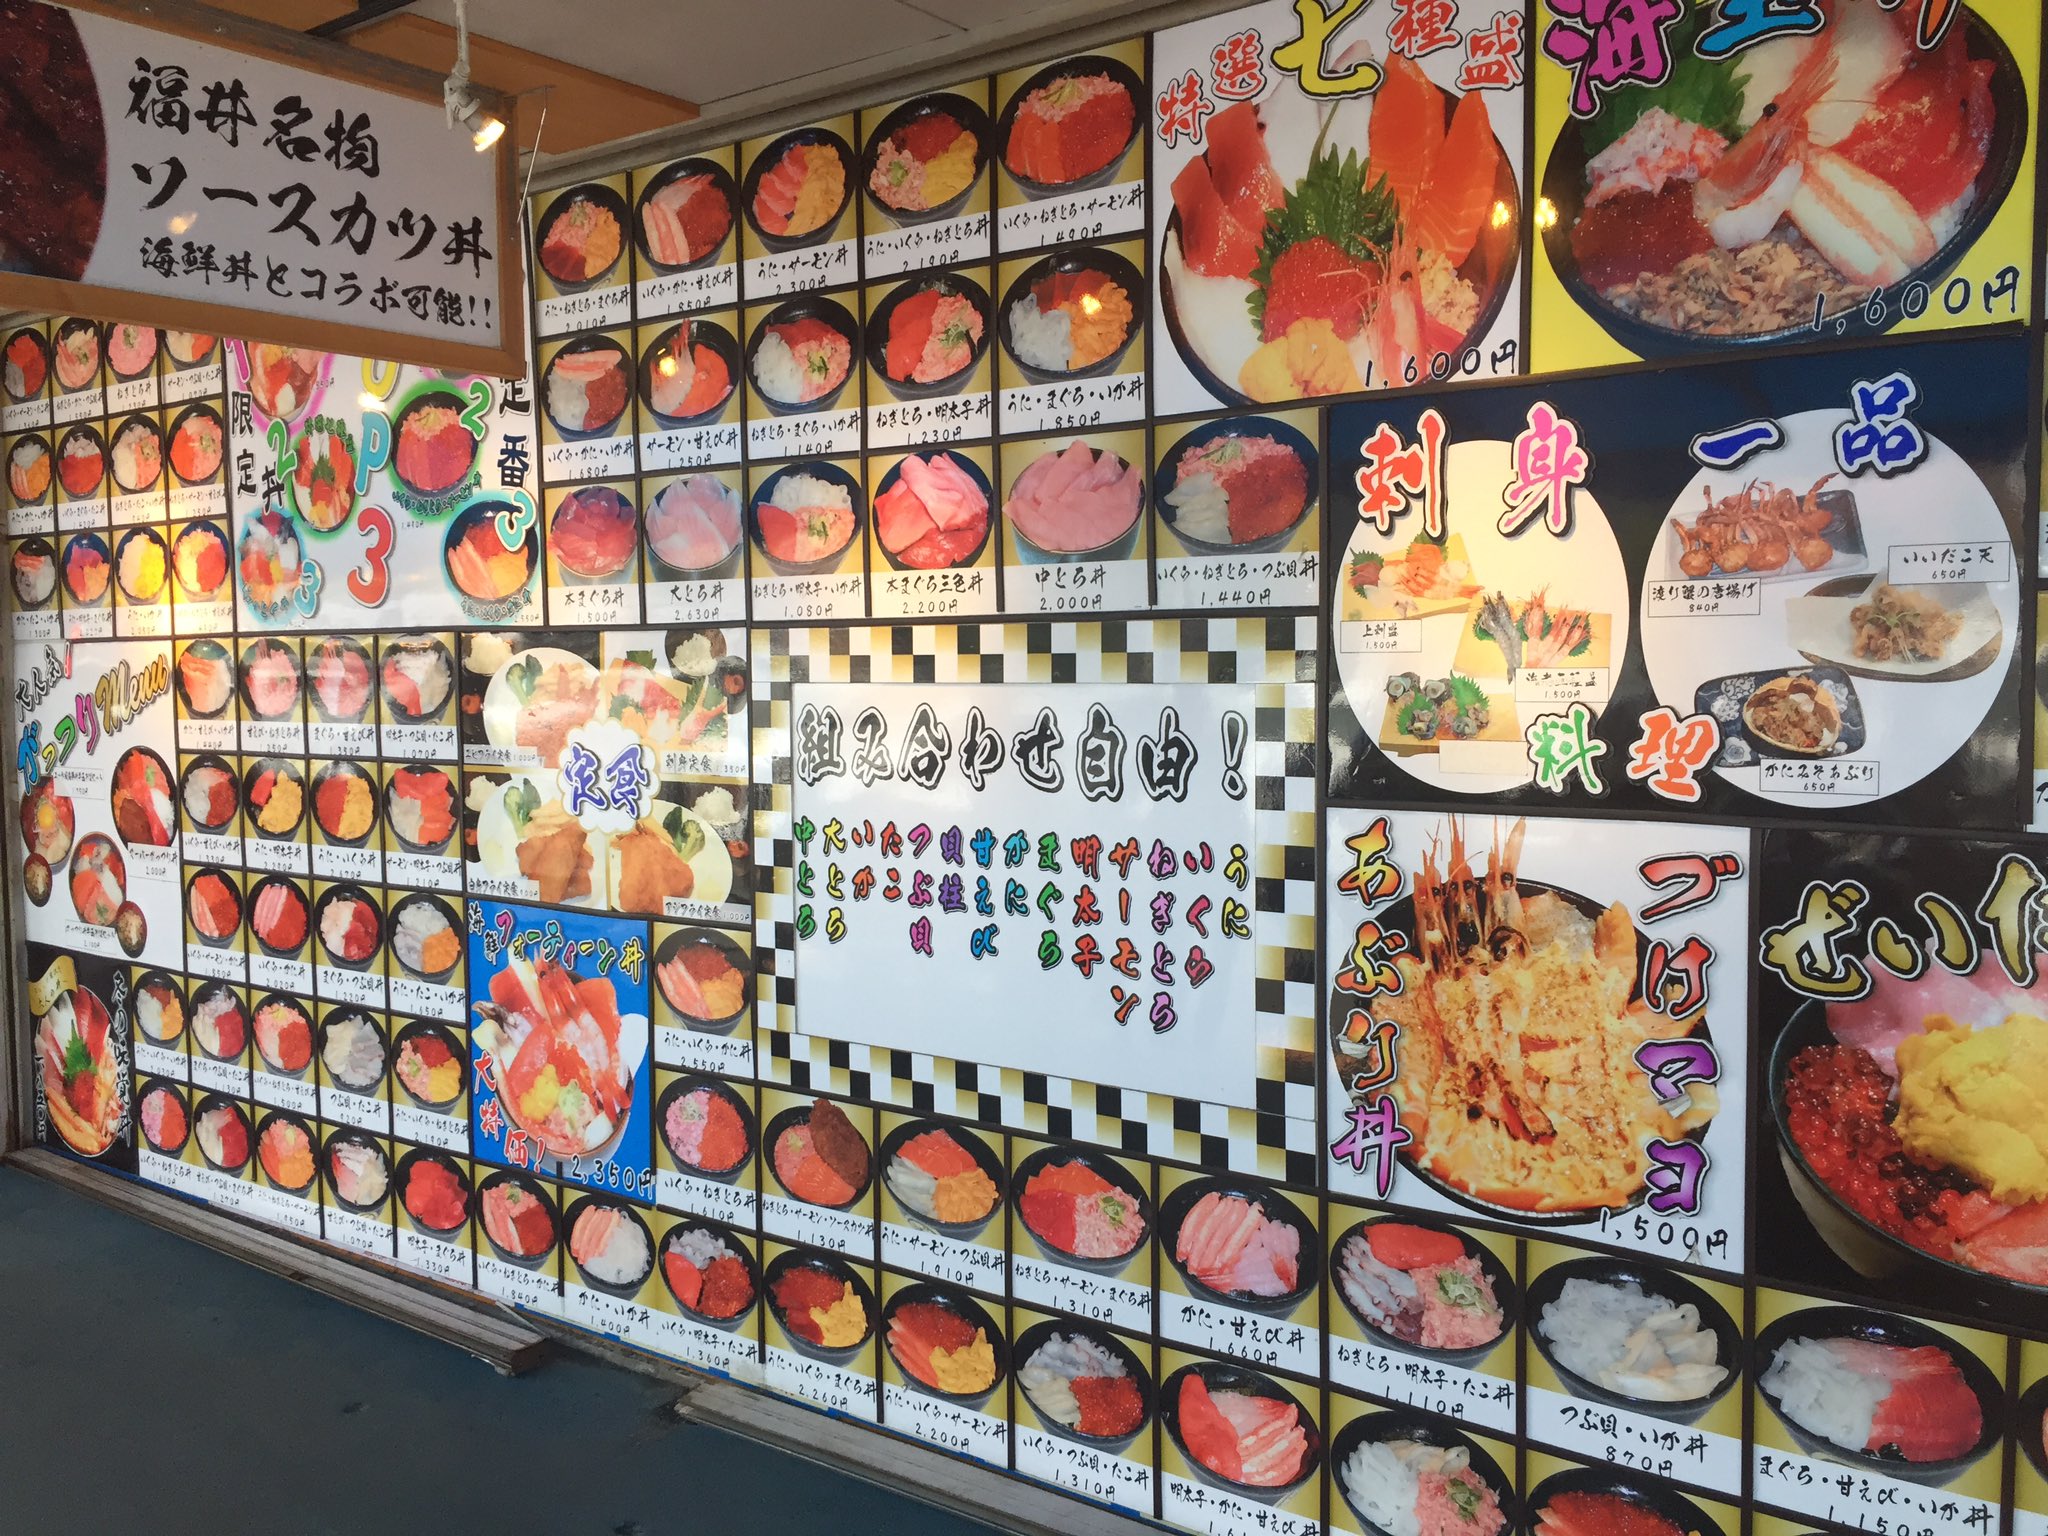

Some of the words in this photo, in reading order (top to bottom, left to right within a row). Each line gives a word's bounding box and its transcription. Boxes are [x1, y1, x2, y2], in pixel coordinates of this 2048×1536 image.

[1156, 0, 1525, 149] 特選七種盛
[125, 57, 380, 178] 福井名物
[131, 156, 494, 278] ソースカツ丼
[867, 214, 990, 257] うに・いくら・ねぎとろ丼
[1003, 184, 1145, 230] いくら・ねぎとろ・サーモン丼
[758, 243, 848, 279] うに・サーモン丼
[1811, 265, 2022, 334] 1,600円
[1364, 339, 1518, 389] 1,600円
[876, 394, 993, 428] ねぎとろ・明太子丼
[1007, 375, 1144, 413] うに・まぐろ・いか丼
[647, 427, 738, 452] サーモン・甘えび丼
[751, 410, 861, 442] ねぎとろ・まぐろ・いか丼
[1689, 374, 1929, 479] 一品
[1357, 402, 1596, 540] 刺身
[1035, 564, 1107, 593] 中とろ丼
[1157, 555, 1319, 588] いくら・ねぎとろ・つぶ貝丼
[1903, 546, 1995, 566] いいだこ天
[1931, 568, 1967, 580] 650円
[670, 581, 724, 605] 大とろ丼
[753, 576, 862, 599] ねぎとろ・明太子・いか丼
[1688, 602, 1720, 614] 840円
[94, 652, 170, 737] Menu
[562, 740, 651, 819] 定食
[1526, 703, 1724, 804] 料理
[1803, 782, 1836, 793] 650円
[794, 814, 818, 941] 中とろ
[822, 816, 849, 944] 大とろ
[851, 818, 877, 901] いか
[880, 820, 904, 899] たこ
[938, 825, 967, 915] 貝柱
[1004, 828, 1031, 917] かに
[908, 821, 934, 958] つぶ貝
[970, 826, 999, 960] 甘えび
[1037, 831, 1063, 970] まぐろ
[1071, 833, 1104, 977] 明太子
[1184, 842, 1215, 988] いくら
[1221, 843, 1252, 939] うに
[1108, 836, 1141, 1025] サーモン
[1147, 838, 1179, 1034] ねぎとろ
[1330, 815, 1413, 1199] あぶり丼
[664, 1032, 752, 1064] うに・いくら・かに丼
[570, 1153, 657, 1199] 2,350円
[664, 1177, 757, 1214] いくら・ねぎとろ丼
[881, 1227, 1006, 1276] うに・サーモン・つぶ貝丼
[1600, 1206, 1729, 1261] 1,500円
[578, 1291, 651, 1330] かに・いか丼
[1015, 1262, 1152, 1315] ねぎとろ・サーモン・まぐろ丼
[1180, 1304, 1306, 1354] かに・甘えび丼
[768, 1351, 877, 1403] うに・いくら・まぐろ丼
[1337, 1344, 1515, 1410] ねぎとろ・明太子・たこ丼
[885, 1388, 1007, 1445] うに・いくら・サーモン丼
[1559, 1405, 1708, 1463] つぶ貝・いか丼
[1022, 1435, 1150, 1492] いくら・つぶ貝・たこ丼
[1604, 1445, 1674, 1480] 870円
[1758, 1454, 1995, 1536] まぐろ・甘えび・いか丼
